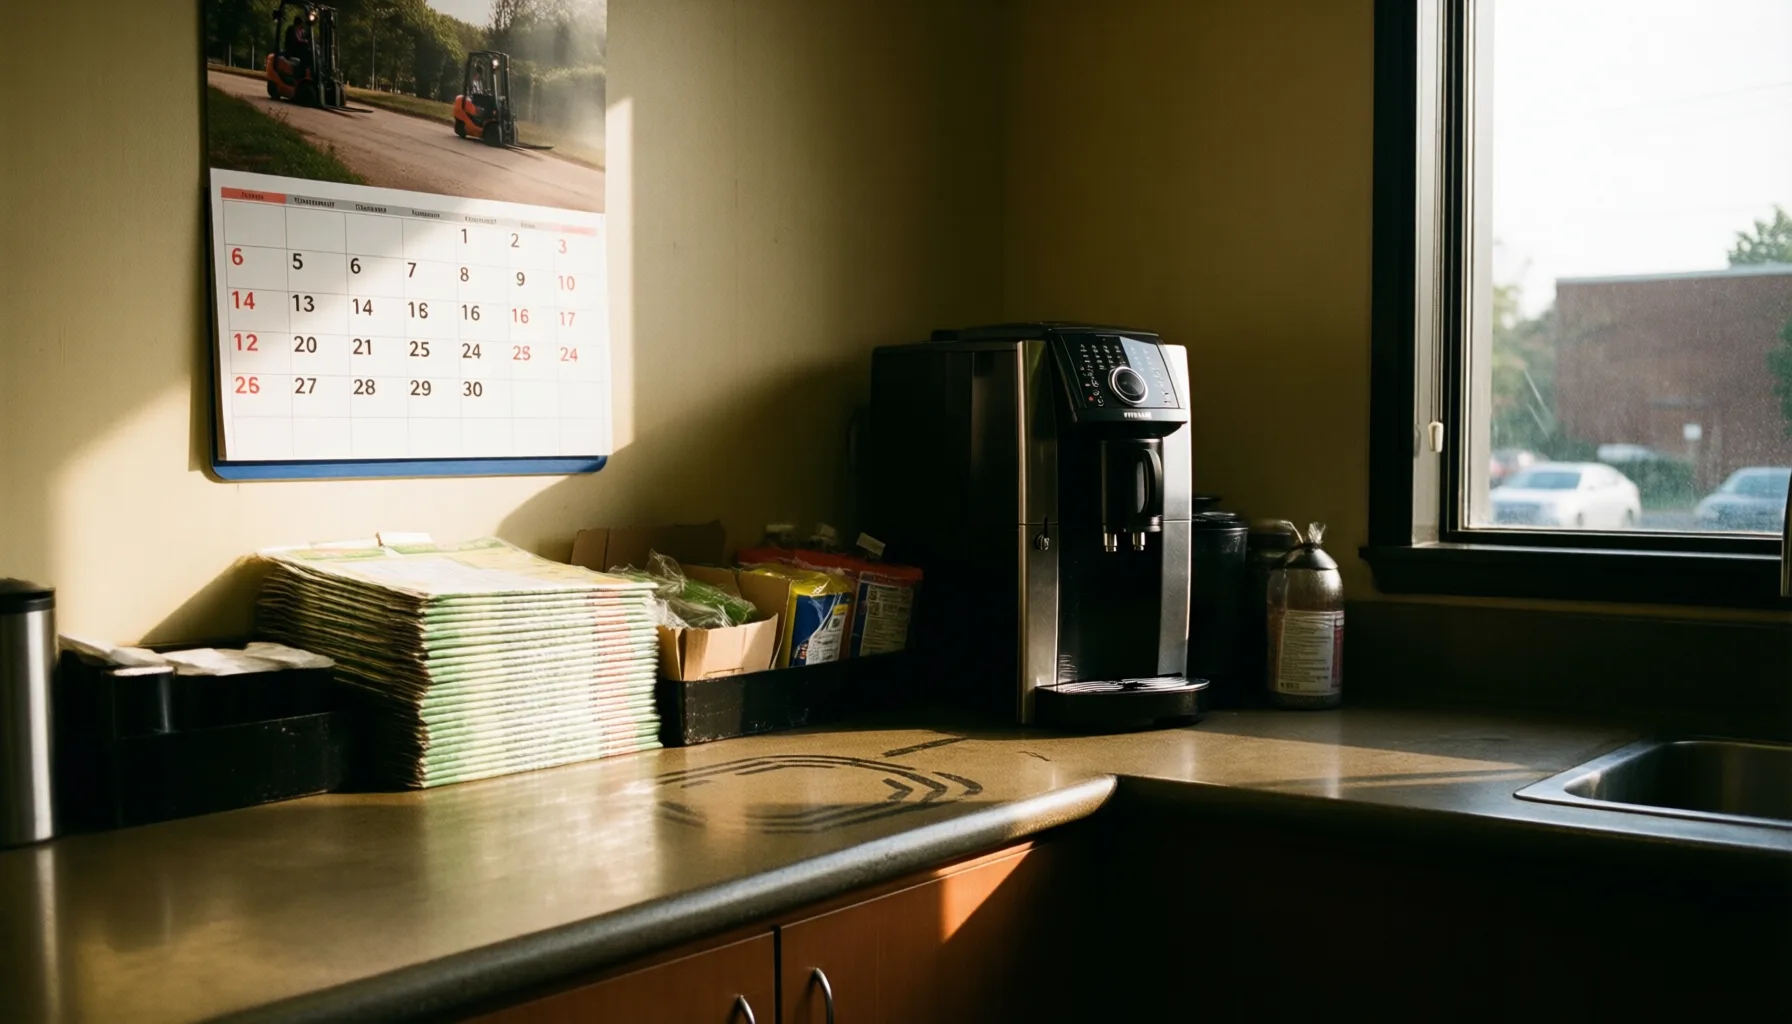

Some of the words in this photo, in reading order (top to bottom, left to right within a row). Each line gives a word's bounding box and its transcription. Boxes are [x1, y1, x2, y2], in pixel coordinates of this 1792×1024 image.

[462, 229, 468, 244] 1
[511, 233, 520, 248] 2
[558, 239, 567, 255] 3
[232, 248, 244, 266] 6
[293, 253, 304, 271] 5
[351, 258, 362, 275] 6
[408, 262, 417, 278] 7
[461, 267, 470, 283] 8
[517, 272, 526, 287] 9
[559, 276, 576, 291] 10
[232, 291, 256, 310] 14
[293, 295, 315, 313] 13
[353, 299, 373, 316] 14
[462, 305, 481, 322] 16
[512, 309, 529, 324] 16
[560, 312, 576, 327] 17
[234, 333, 258, 352] 12
[294, 336, 318, 354] 20
[353, 339, 372, 356] 21
[410, 341, 430, 358] 25
[462, 343, 482, 360] 24
[561, 347, 578, 362] 24
[236, 376, 260, 394] 26
[295, 378, 317, 395] 27
[354, 379, 376, 396] 28
[411, 380, 432, 397] 29
[464, 381, 483, 398] 30
